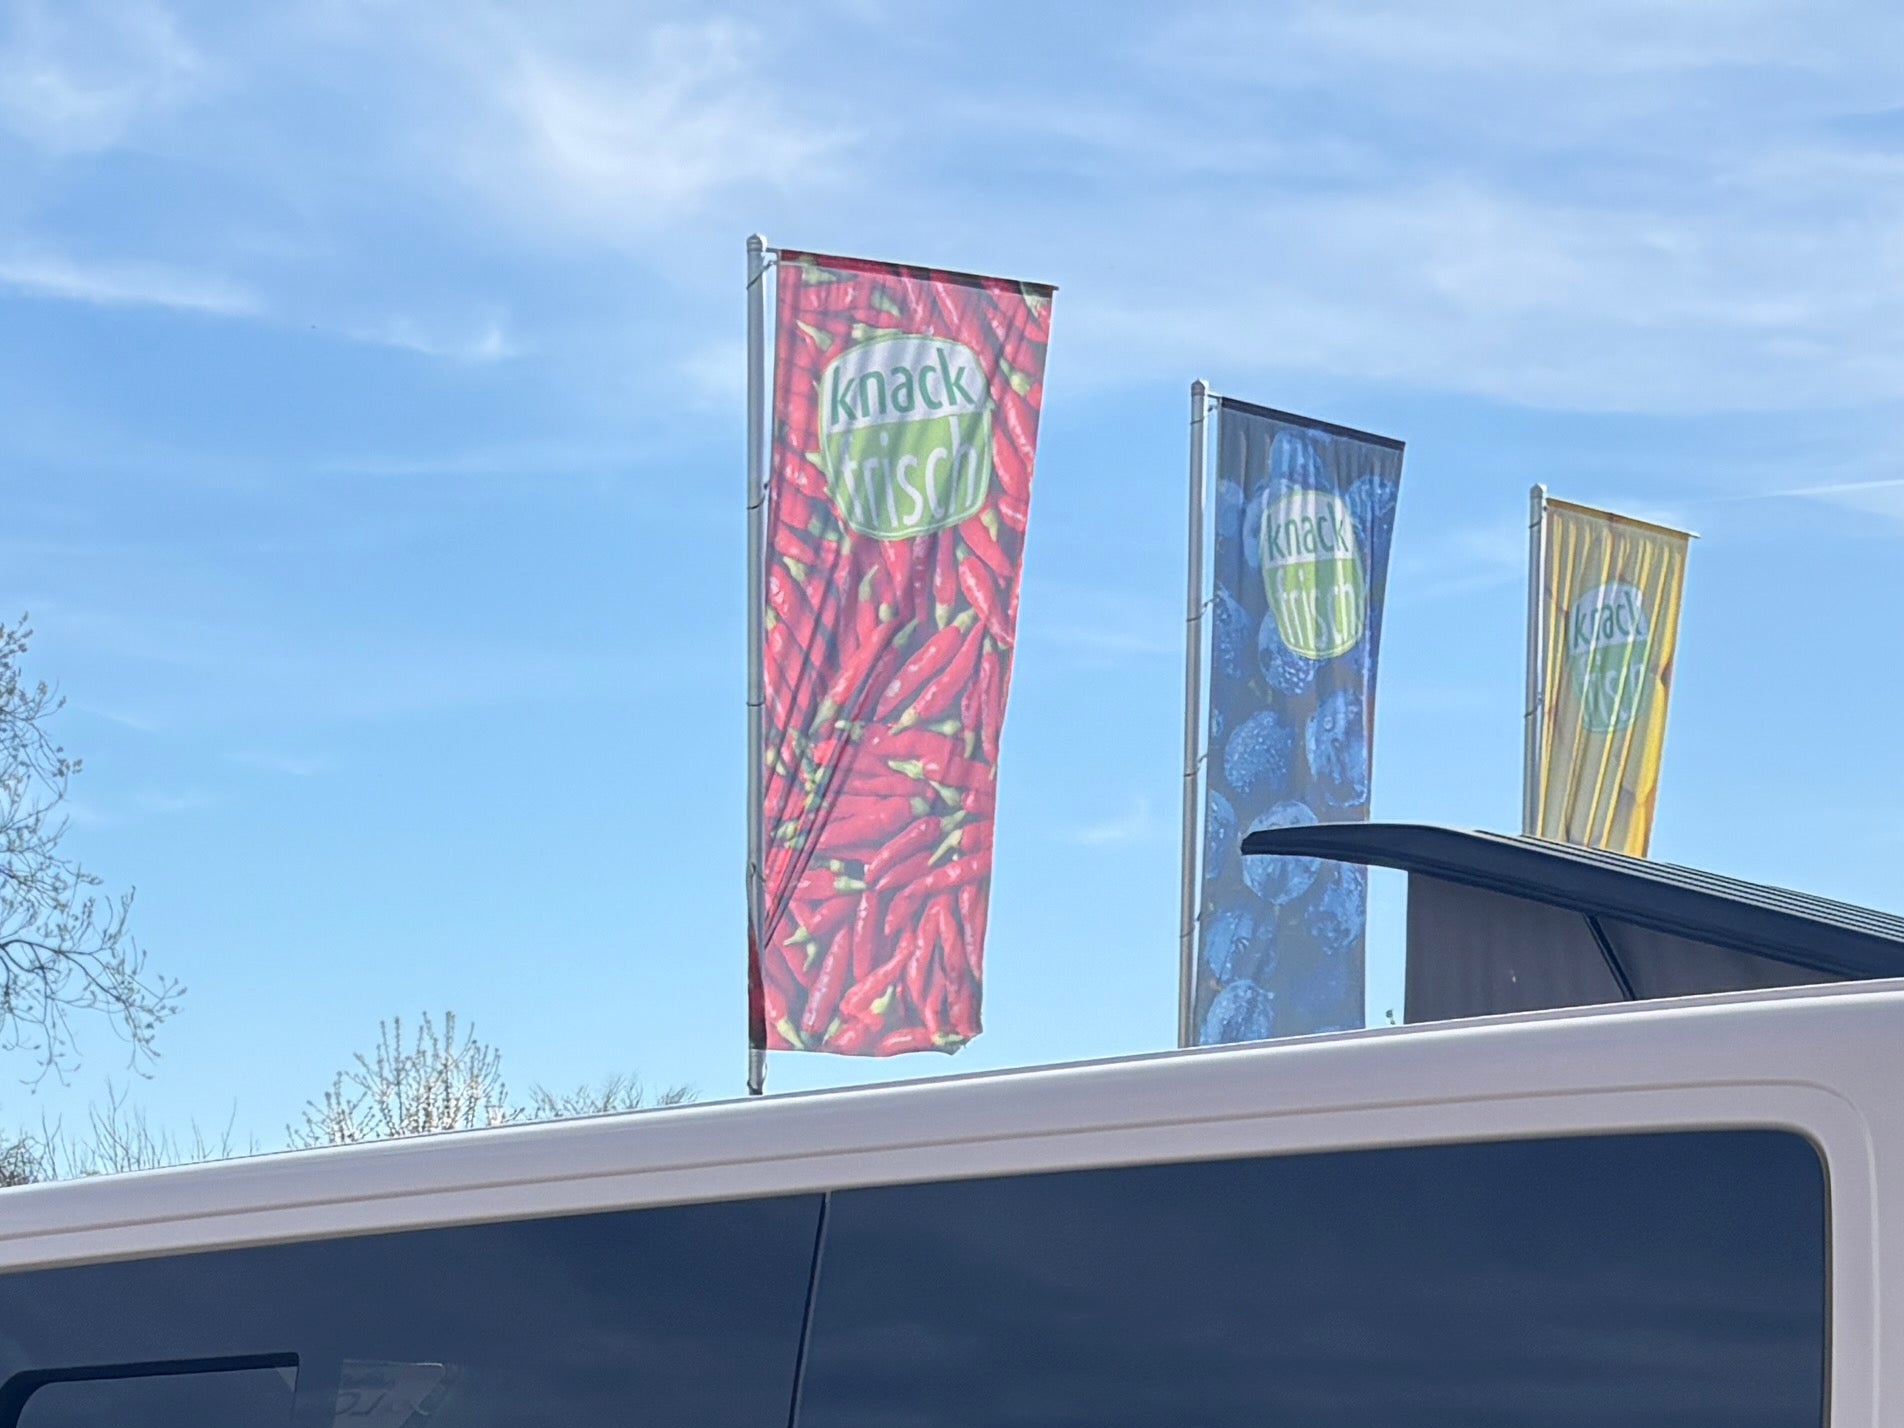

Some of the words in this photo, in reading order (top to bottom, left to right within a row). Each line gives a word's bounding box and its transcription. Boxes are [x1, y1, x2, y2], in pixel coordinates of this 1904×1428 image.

[831, 347, 976, 426] knack
[840, 414, 978, 528] frisch
[1267, 501, 1349, 561] knack
[1276, 558, 1358, 651] frisch
